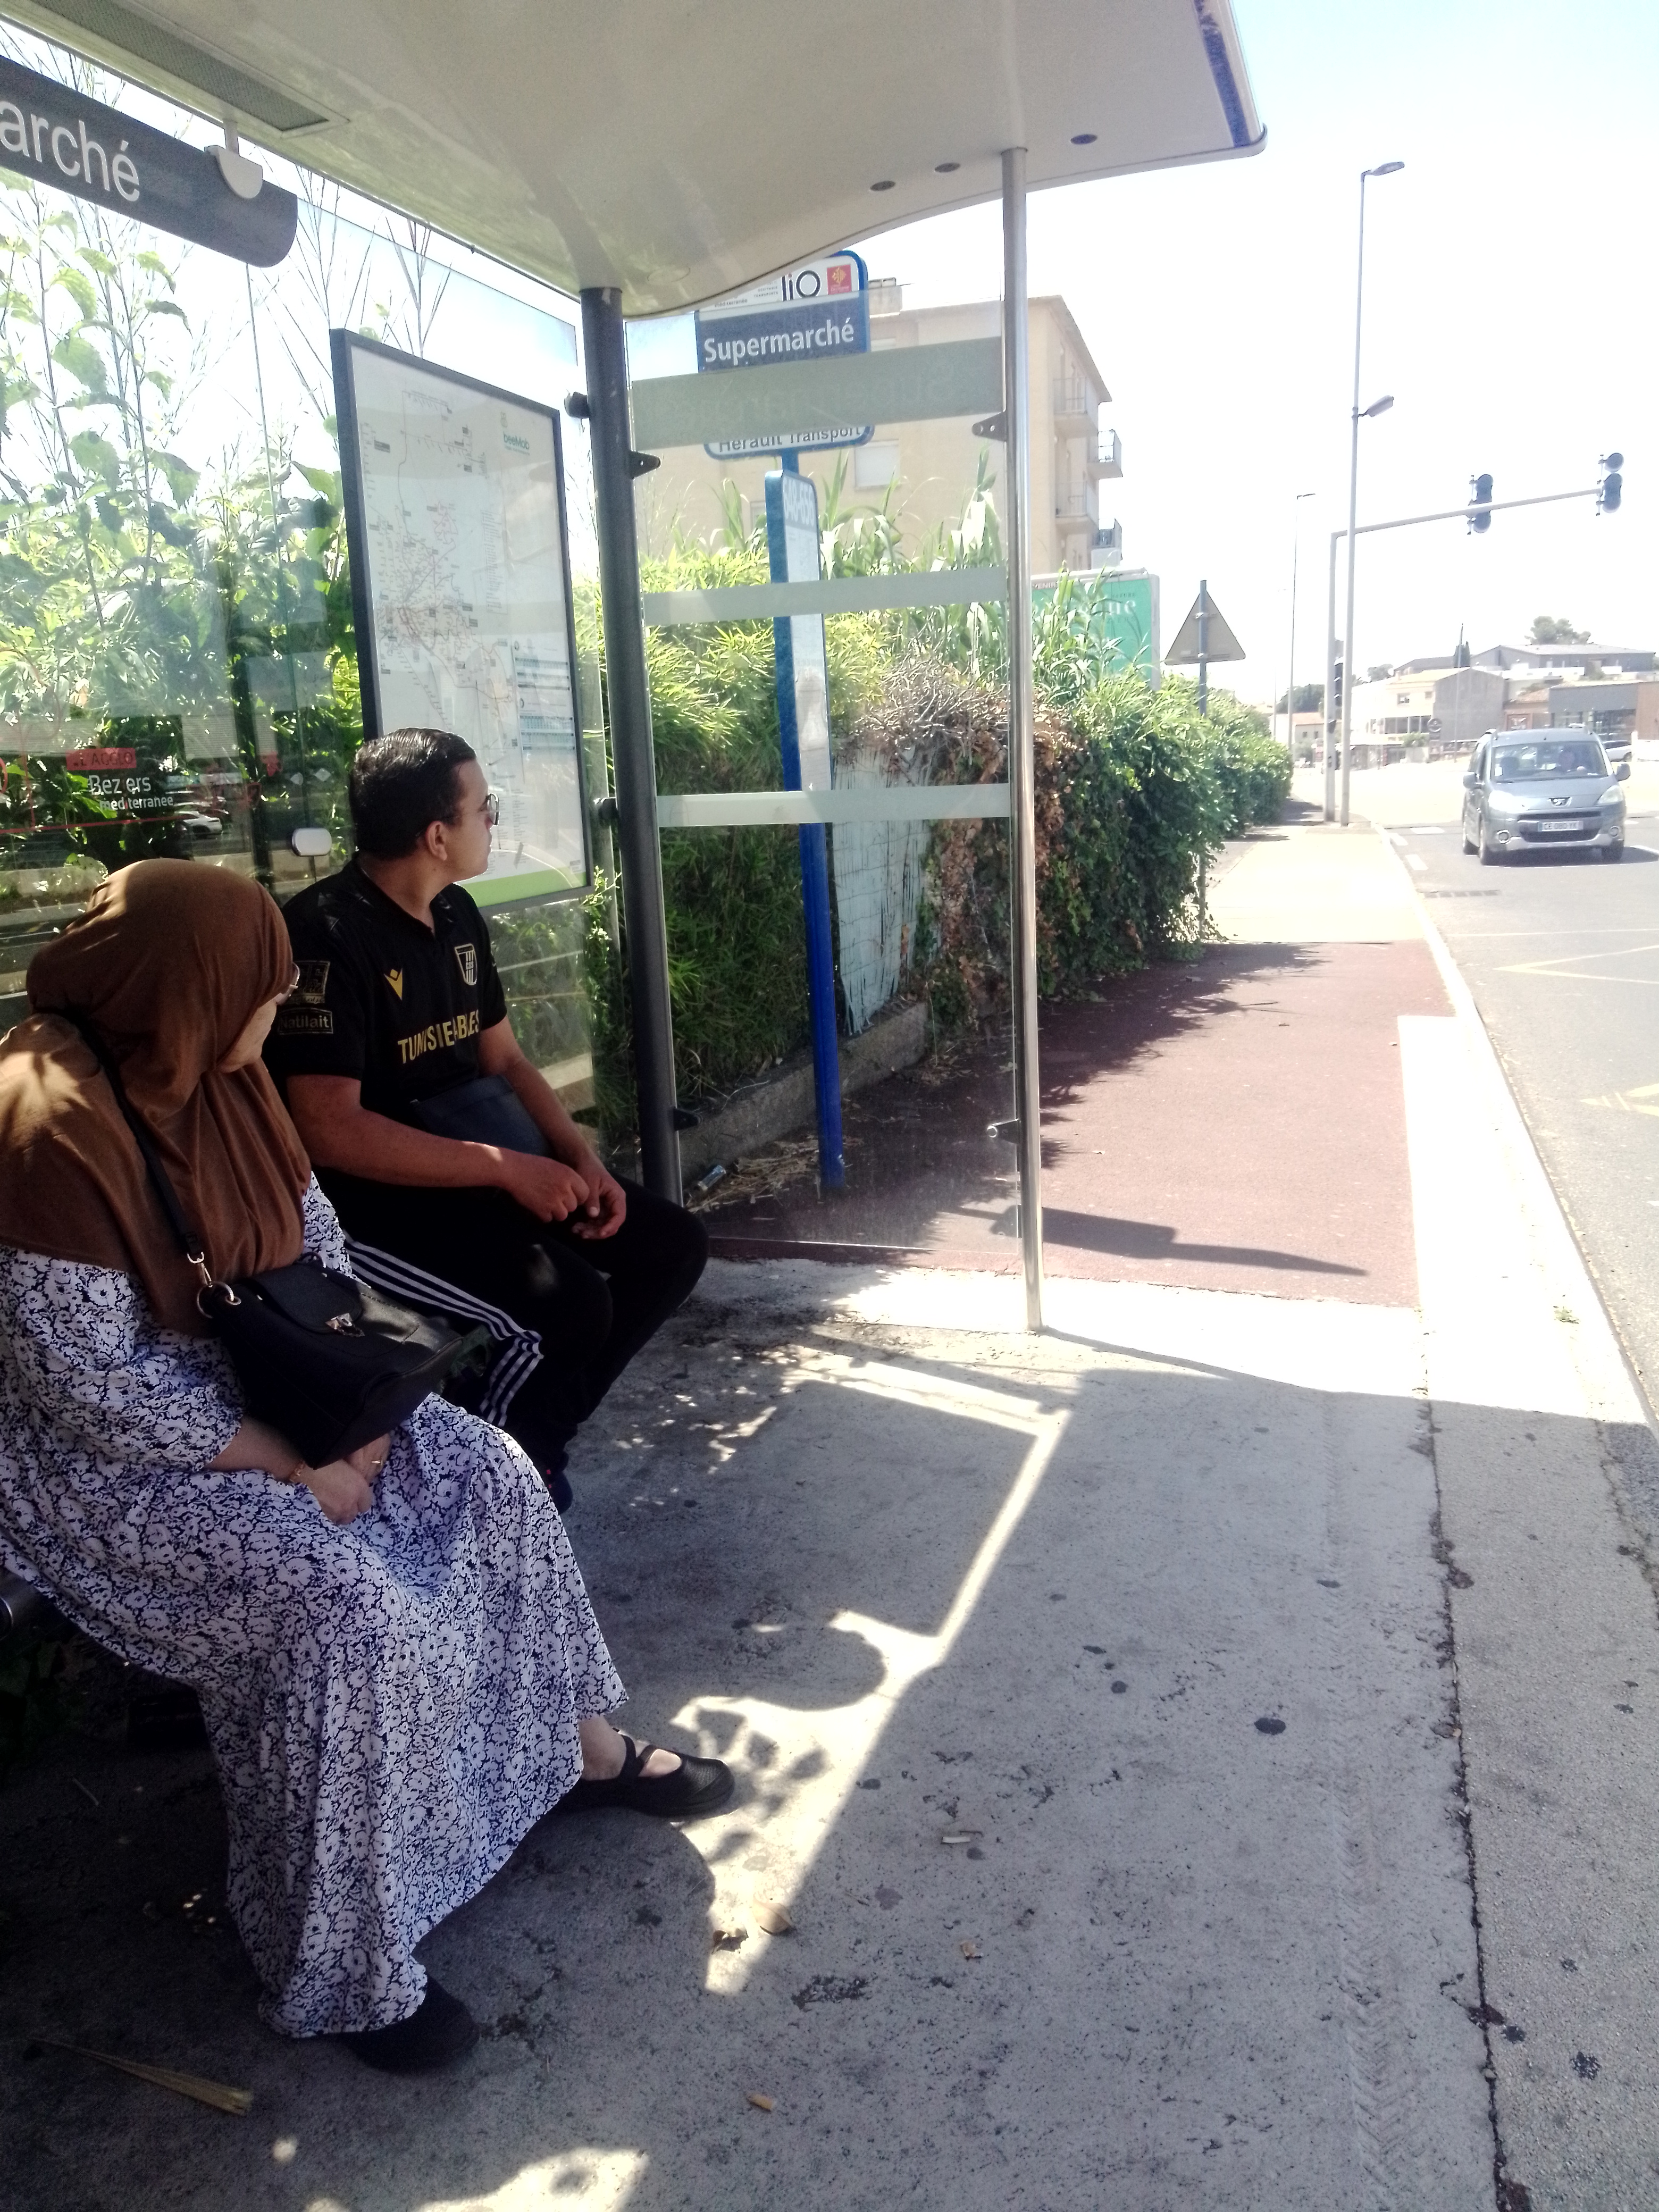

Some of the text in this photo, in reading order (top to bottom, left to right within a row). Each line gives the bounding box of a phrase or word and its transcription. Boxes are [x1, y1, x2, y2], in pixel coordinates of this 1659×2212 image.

[0, 101, 140, 202] arché
[704, 317, 854, 366] Supermarché
[790, 426, 862, 443] Transport
[783, 475, 815, 527] 648-656
[280, 1015, 330, 1029] Natilait
